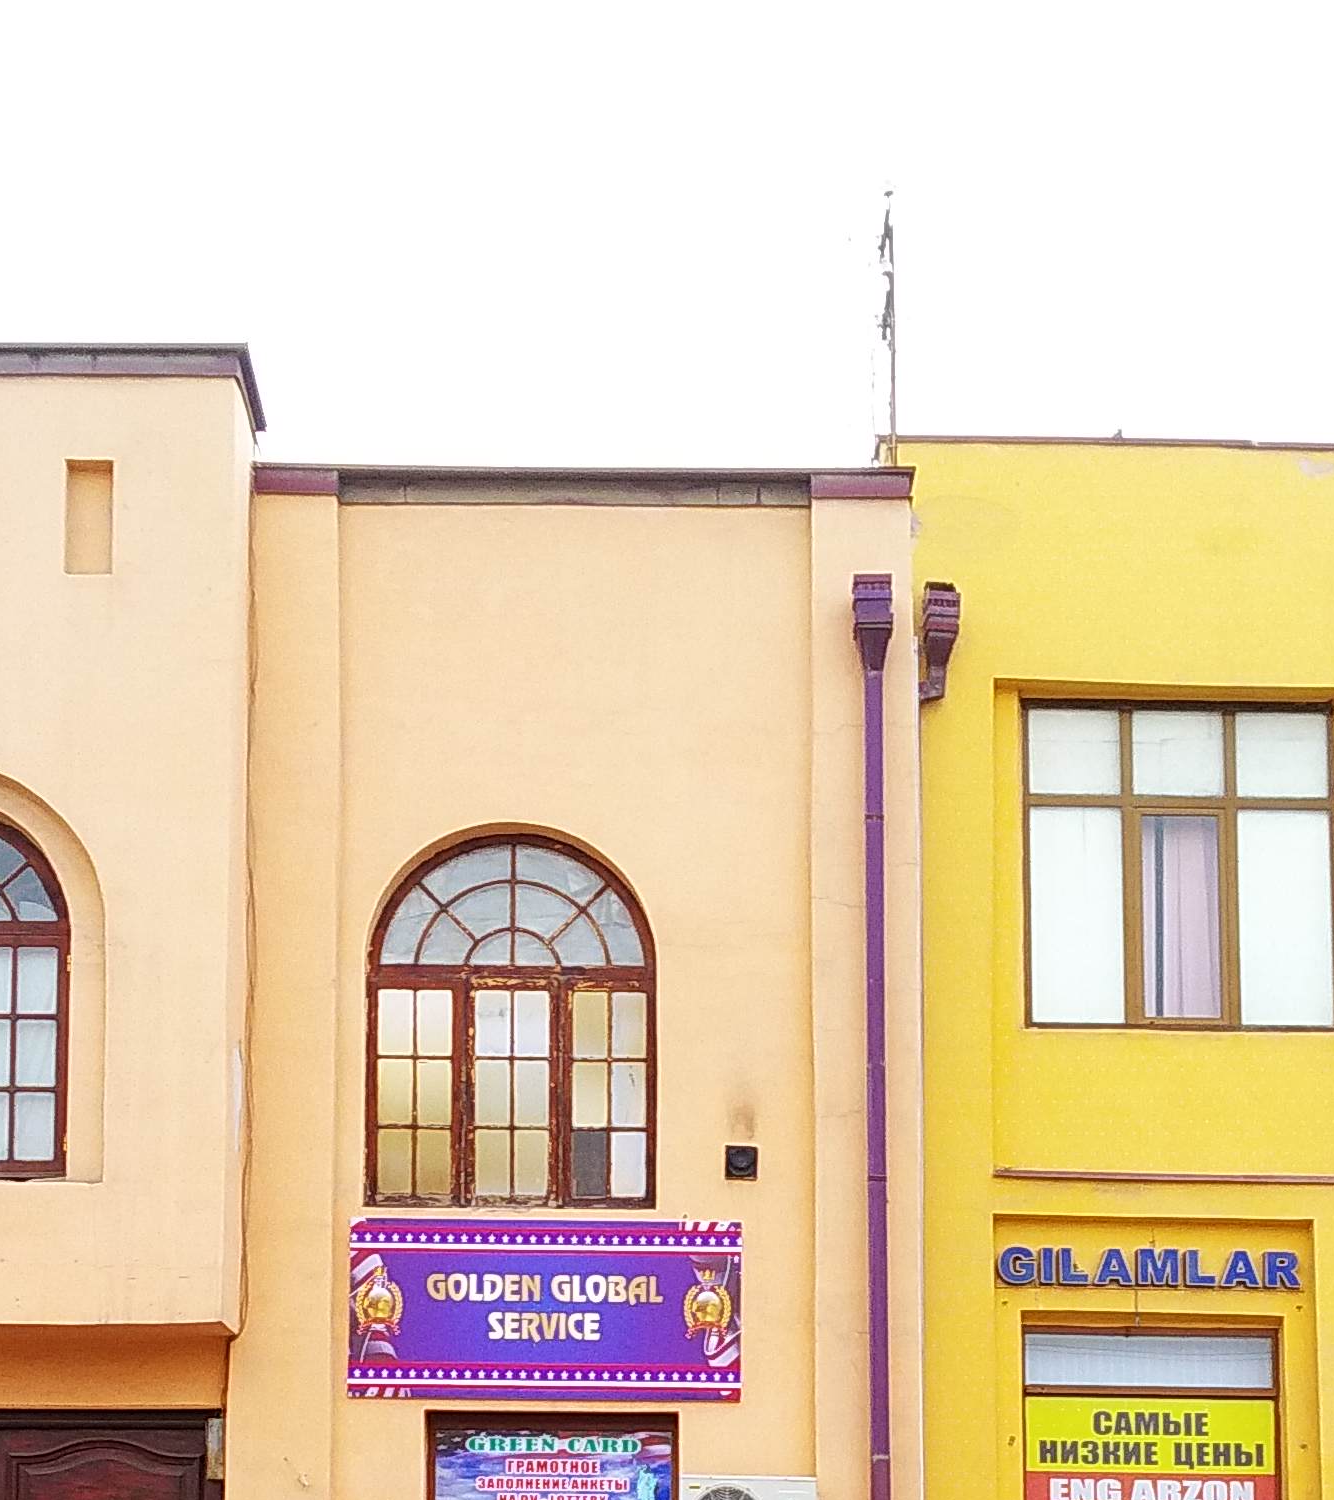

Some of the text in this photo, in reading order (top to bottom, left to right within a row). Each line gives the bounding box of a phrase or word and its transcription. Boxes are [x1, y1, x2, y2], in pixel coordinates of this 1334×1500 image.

[998, 1246, 1302, 1289] GILAMLAR
[426, 1271, 664, 1307] GOLDEN GLOBAL
[488, 1311, 602, 1344] SERVICE
[1092, 1411, 1209, 1436] САМЫЕ
[467, 1436, 640, 1453] GREEN CARD
[1038, 1440, 1265, 1469] НИЗКИЕ ЦЕНЫ
[506, 1460, 600, 1474] ГРАМОТНОЕ
[476, 1477, 629, 1492] ЗАПОЛНЕНИЕ АНКЕТЫ
